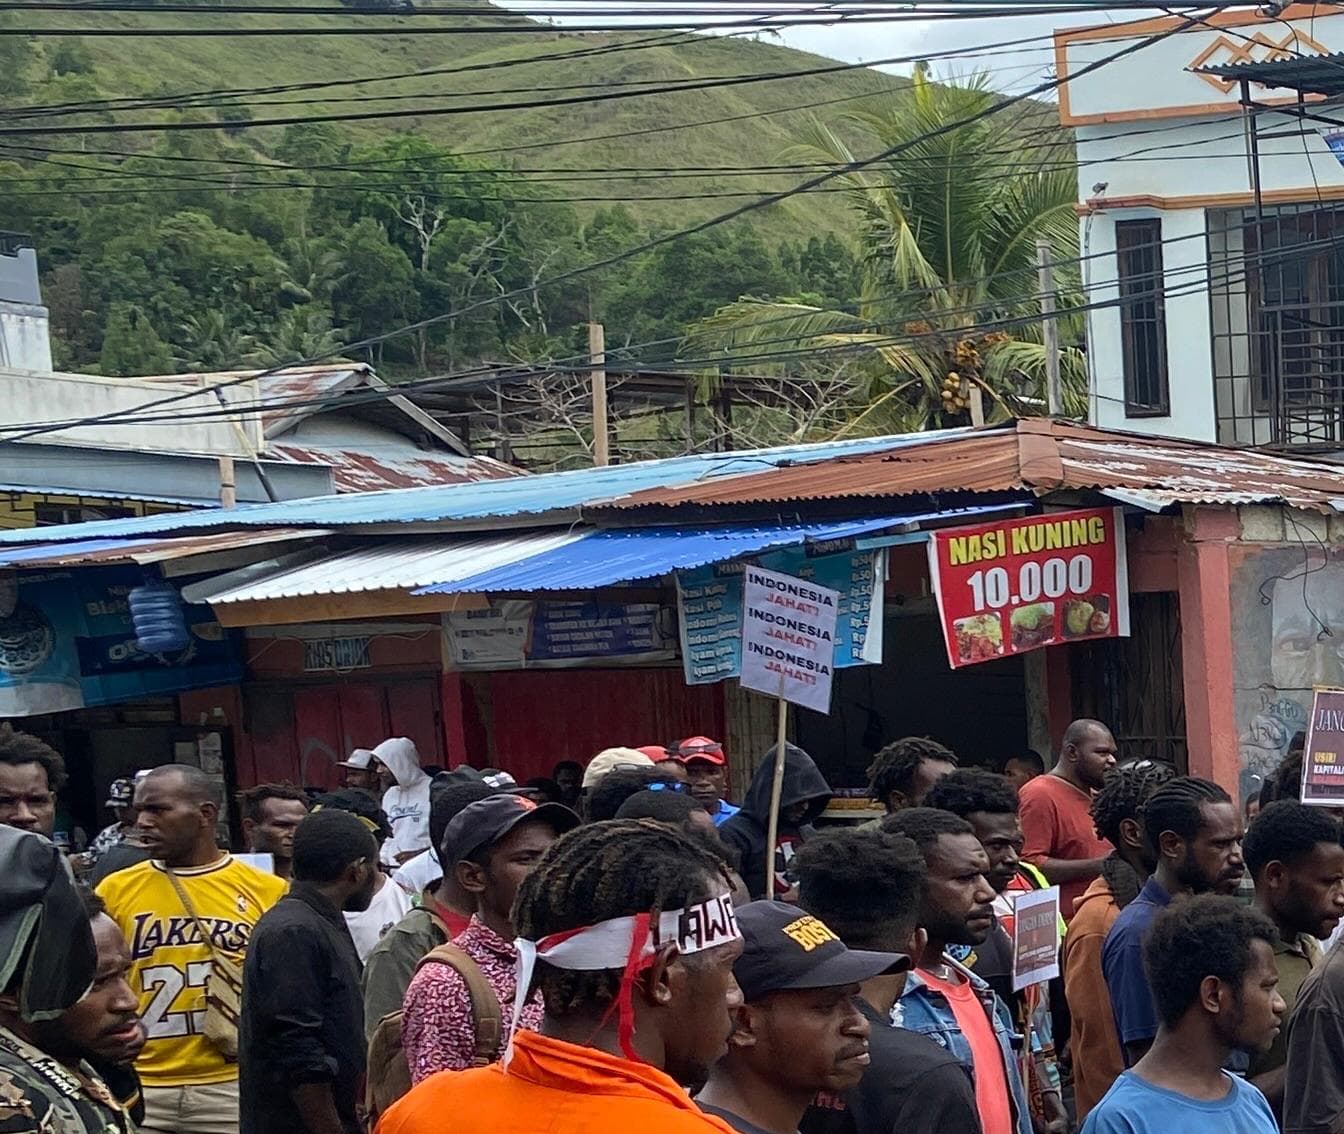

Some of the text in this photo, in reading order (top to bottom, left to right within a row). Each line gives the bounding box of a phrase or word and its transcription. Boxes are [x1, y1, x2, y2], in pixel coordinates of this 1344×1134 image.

[950, 516, 1105, 567] NASI KUNING
[748, 573, 833, 607] INDONESIA
[966, 553, 1093, 612] 10.000
[748, 607, 831, 642] INDONESIA
[748, 641, 830, 676] INDONESIA
[132, 912, 252, 962] LAKERS
